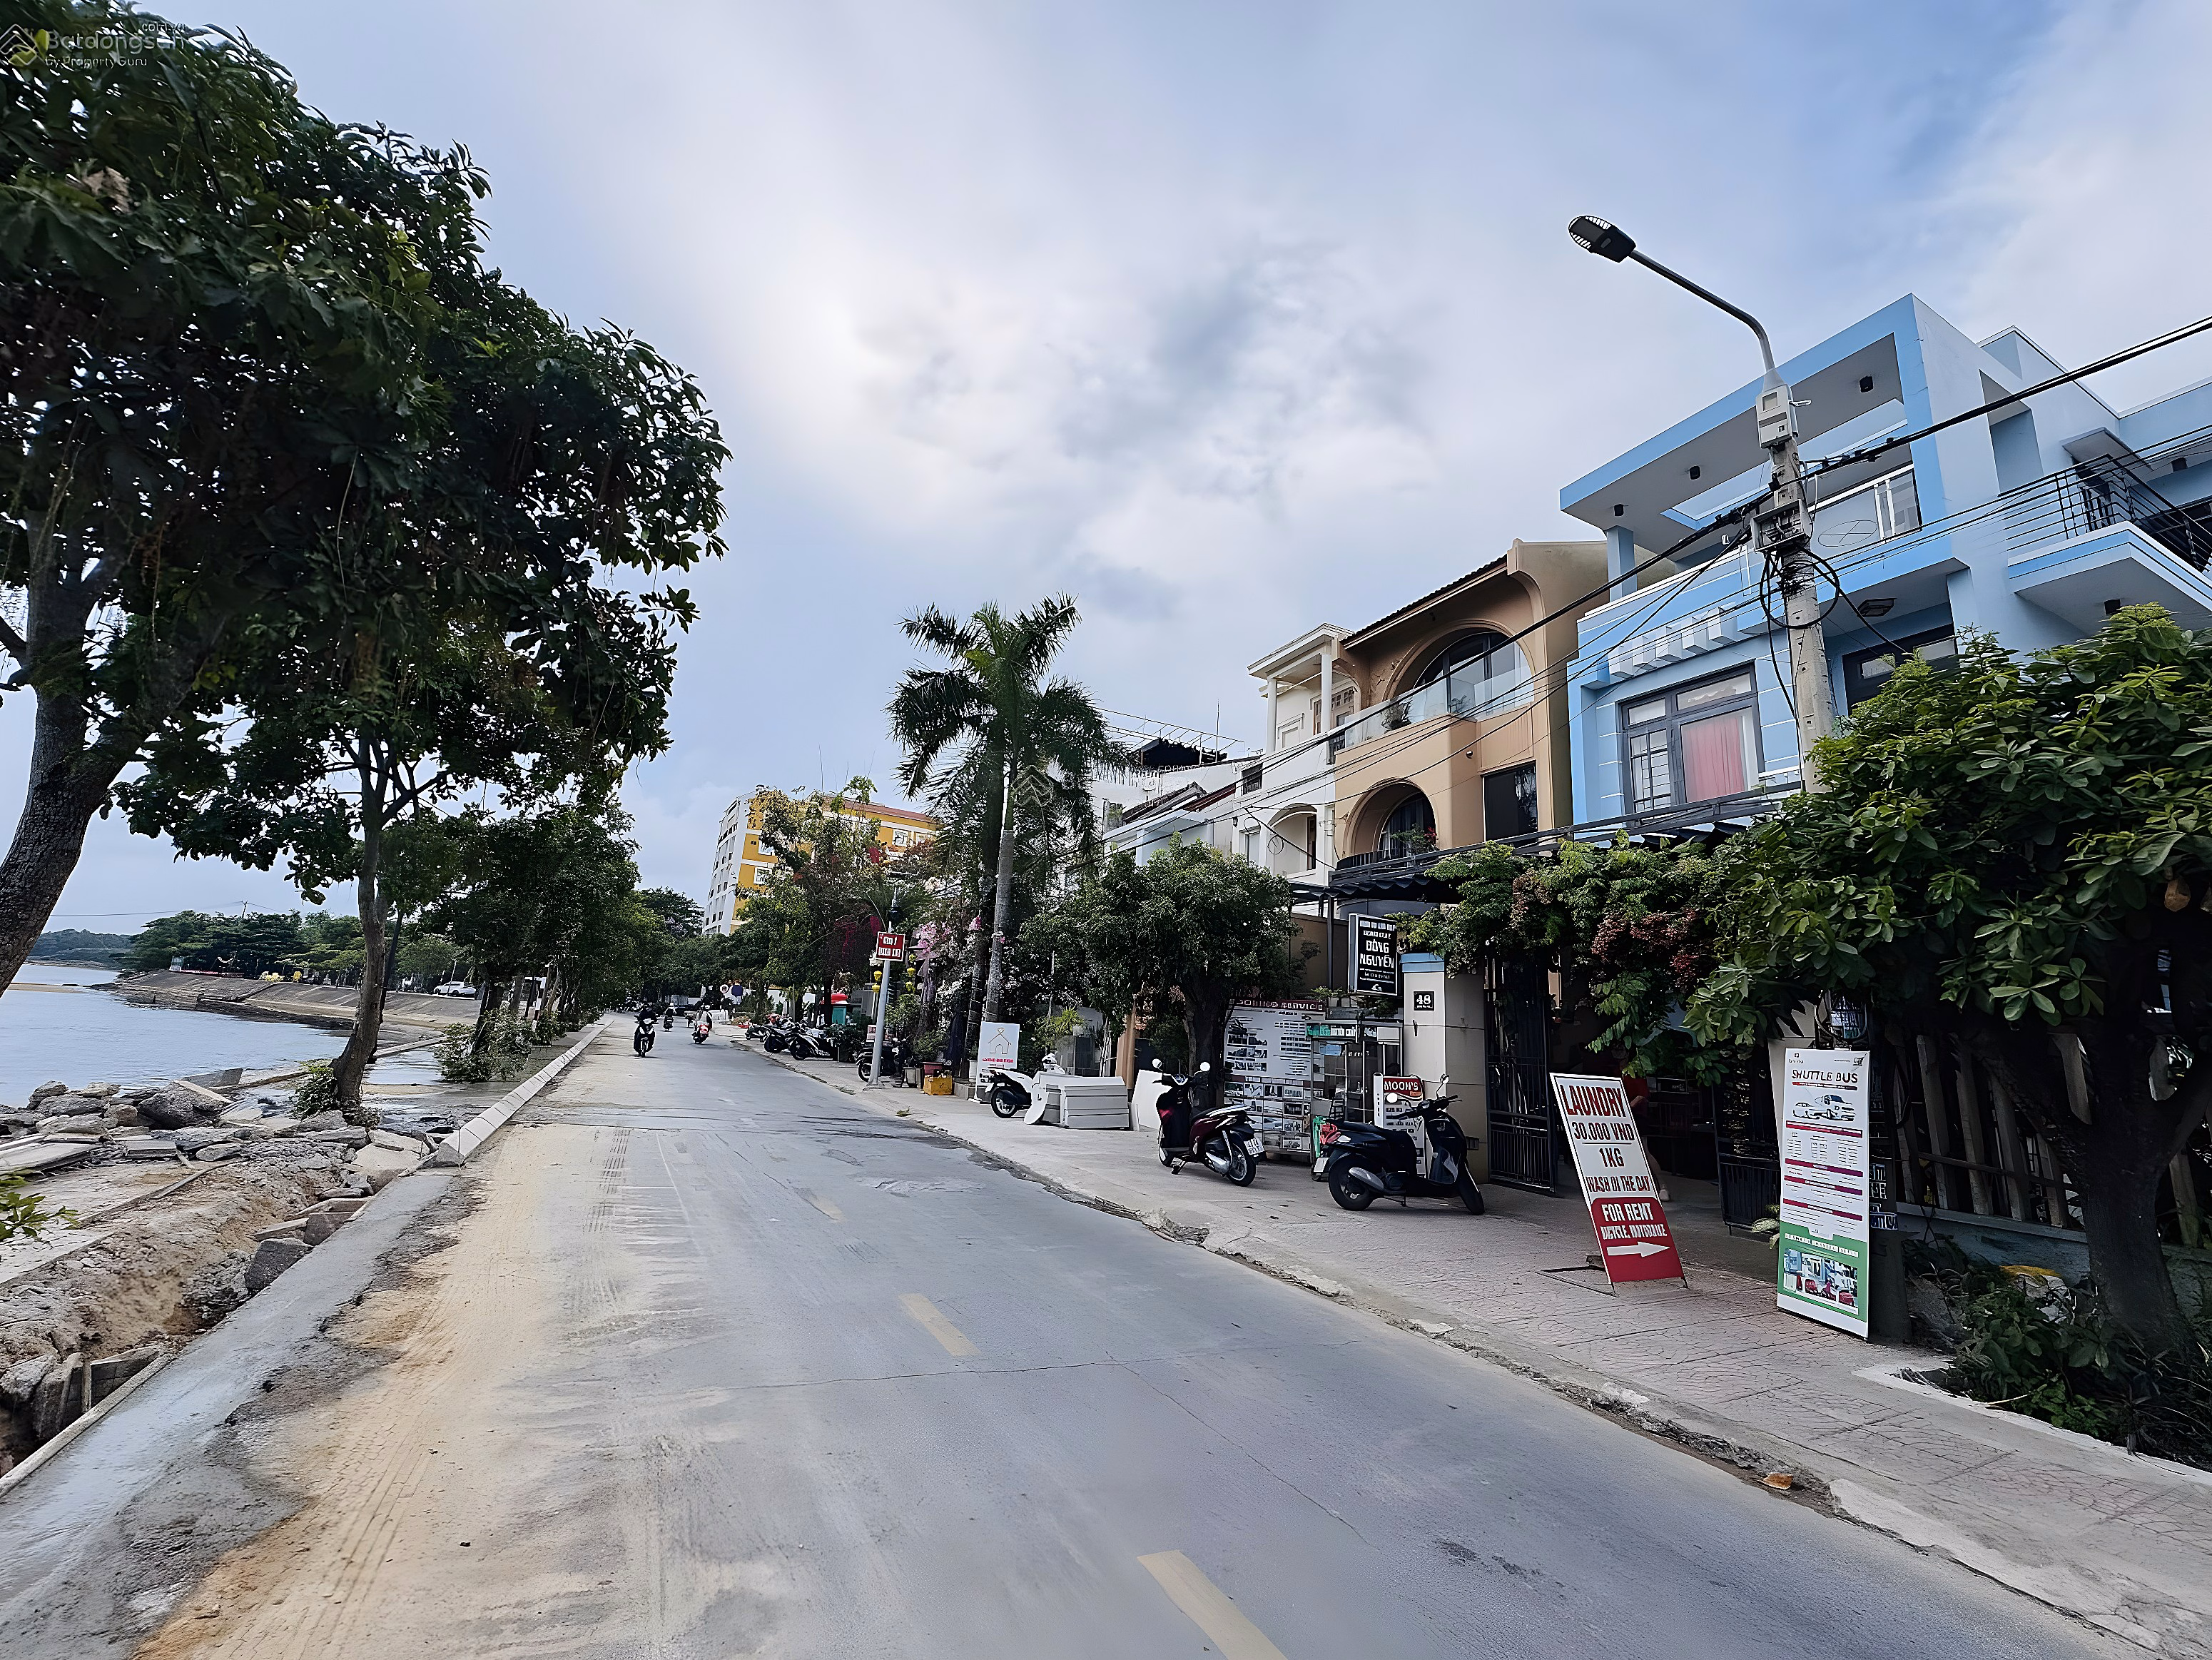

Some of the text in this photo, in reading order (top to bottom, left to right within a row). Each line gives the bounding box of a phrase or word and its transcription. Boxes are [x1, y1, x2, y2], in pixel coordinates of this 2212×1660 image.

[1416, 994, 1431, 1005] 48
[1792, 1069, 1858, 1083] SHUTTLE BUS
[1559, 1084, 1626, 1118] LAUNDRY
[1610, 1123, 1635, 1140] VND
[1599, 1148, 1625, 1168] 1KG
[1585, 1176, 1611, 1193] WASH
[1620, 1175, 1637, 1192] THE
[1635, 1175, 1650, 1192] DAY
[1601, 1203, 1654, 1222] FOR RENT
